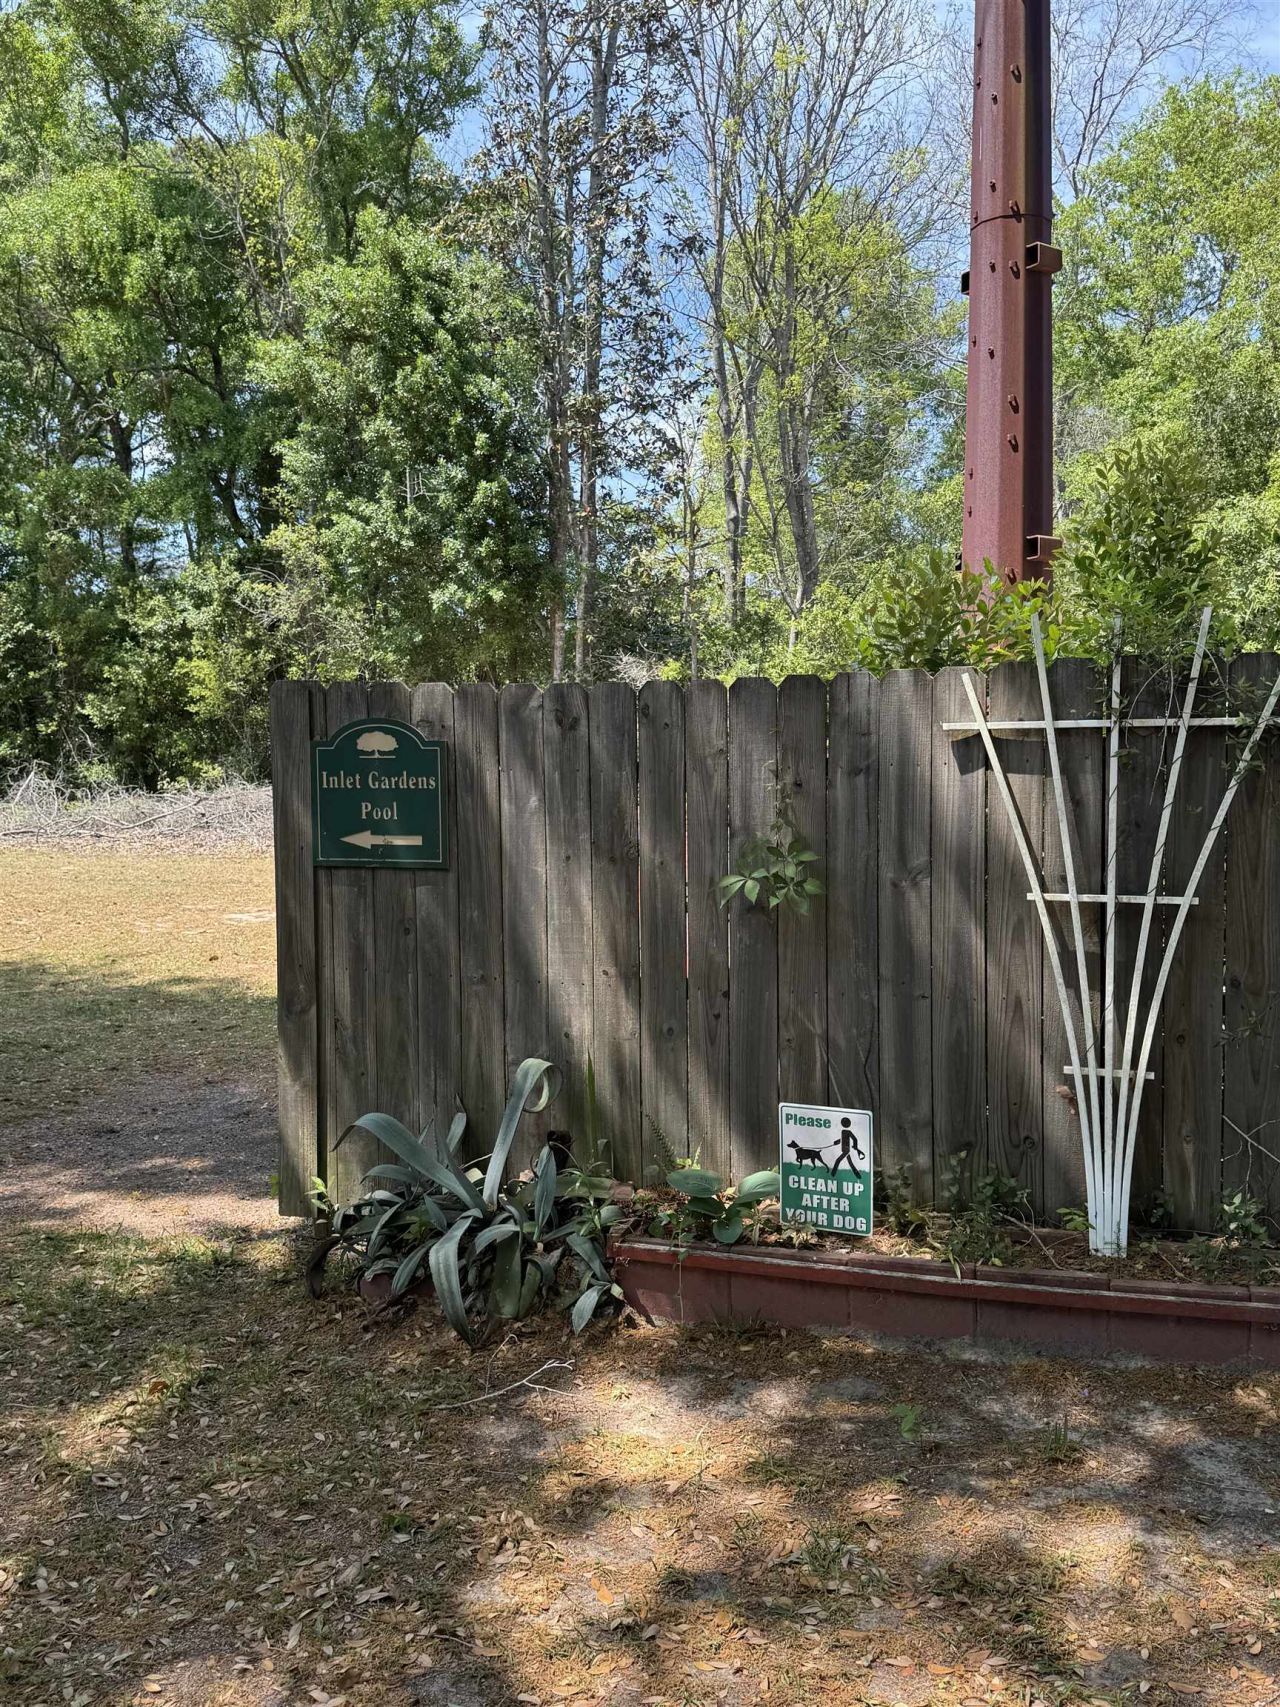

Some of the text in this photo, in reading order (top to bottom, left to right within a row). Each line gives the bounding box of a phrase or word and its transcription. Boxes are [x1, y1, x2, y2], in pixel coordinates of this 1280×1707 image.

[322, 770, 436, 789] Inlet Gardens
[361, 801, 398, 820] Pool
[785, 1113, 831, 1129] Please
[788, 1175, 864, 1196] CLEAN UP
[801, 1193, 850, 1212] AFTER
[785, 1208, 867, 1231] YOUR DOG
